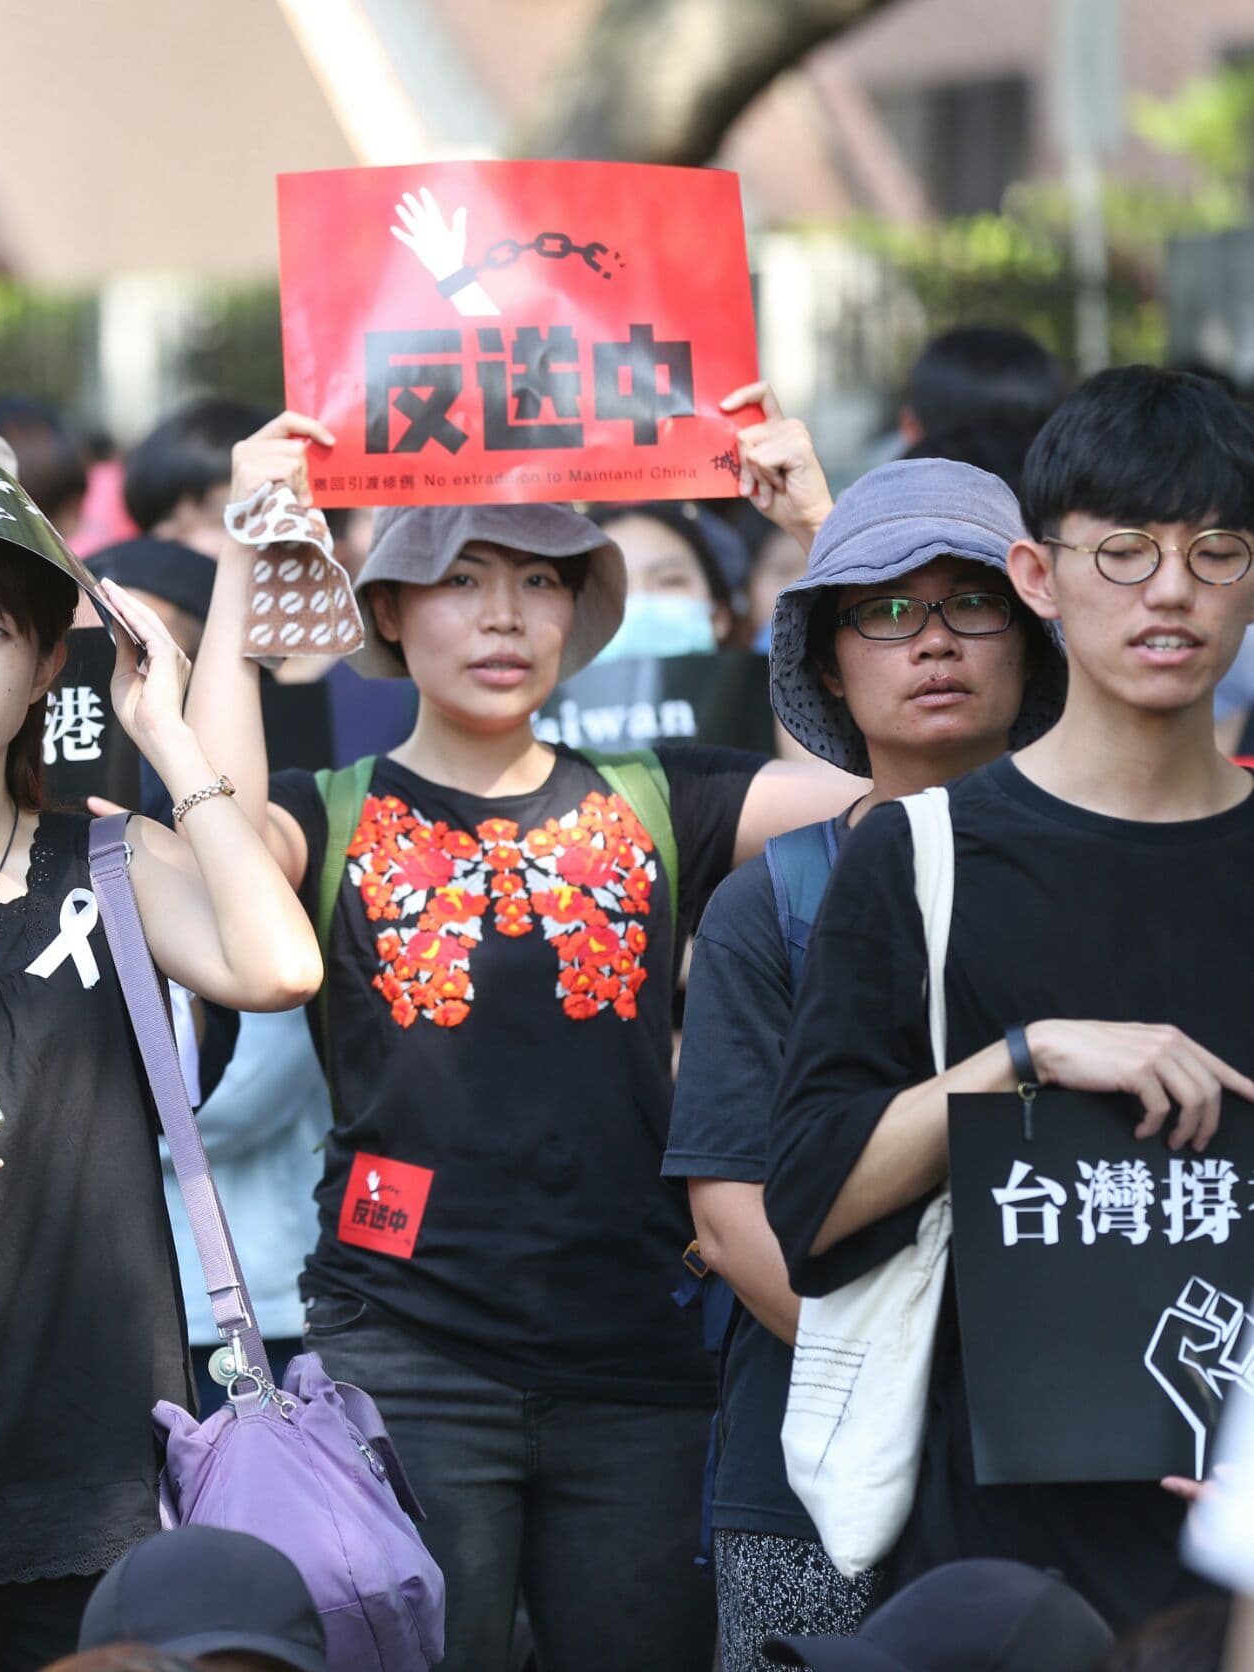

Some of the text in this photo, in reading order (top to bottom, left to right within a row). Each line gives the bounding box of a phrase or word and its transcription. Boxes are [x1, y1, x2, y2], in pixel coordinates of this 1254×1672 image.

[365, 324, 695, 455] 反送中
[424, 474, 446, 487] No
[547, 467, 562, 482] to
[569, 466, 643, 482] Mainland
[650, 466, 697, 481] China
[529, 700, 697, 748] aiwan
[352, 1198, 409, 1234] 反送中
[991, 1158, 1254, 1247] 台灣撐
